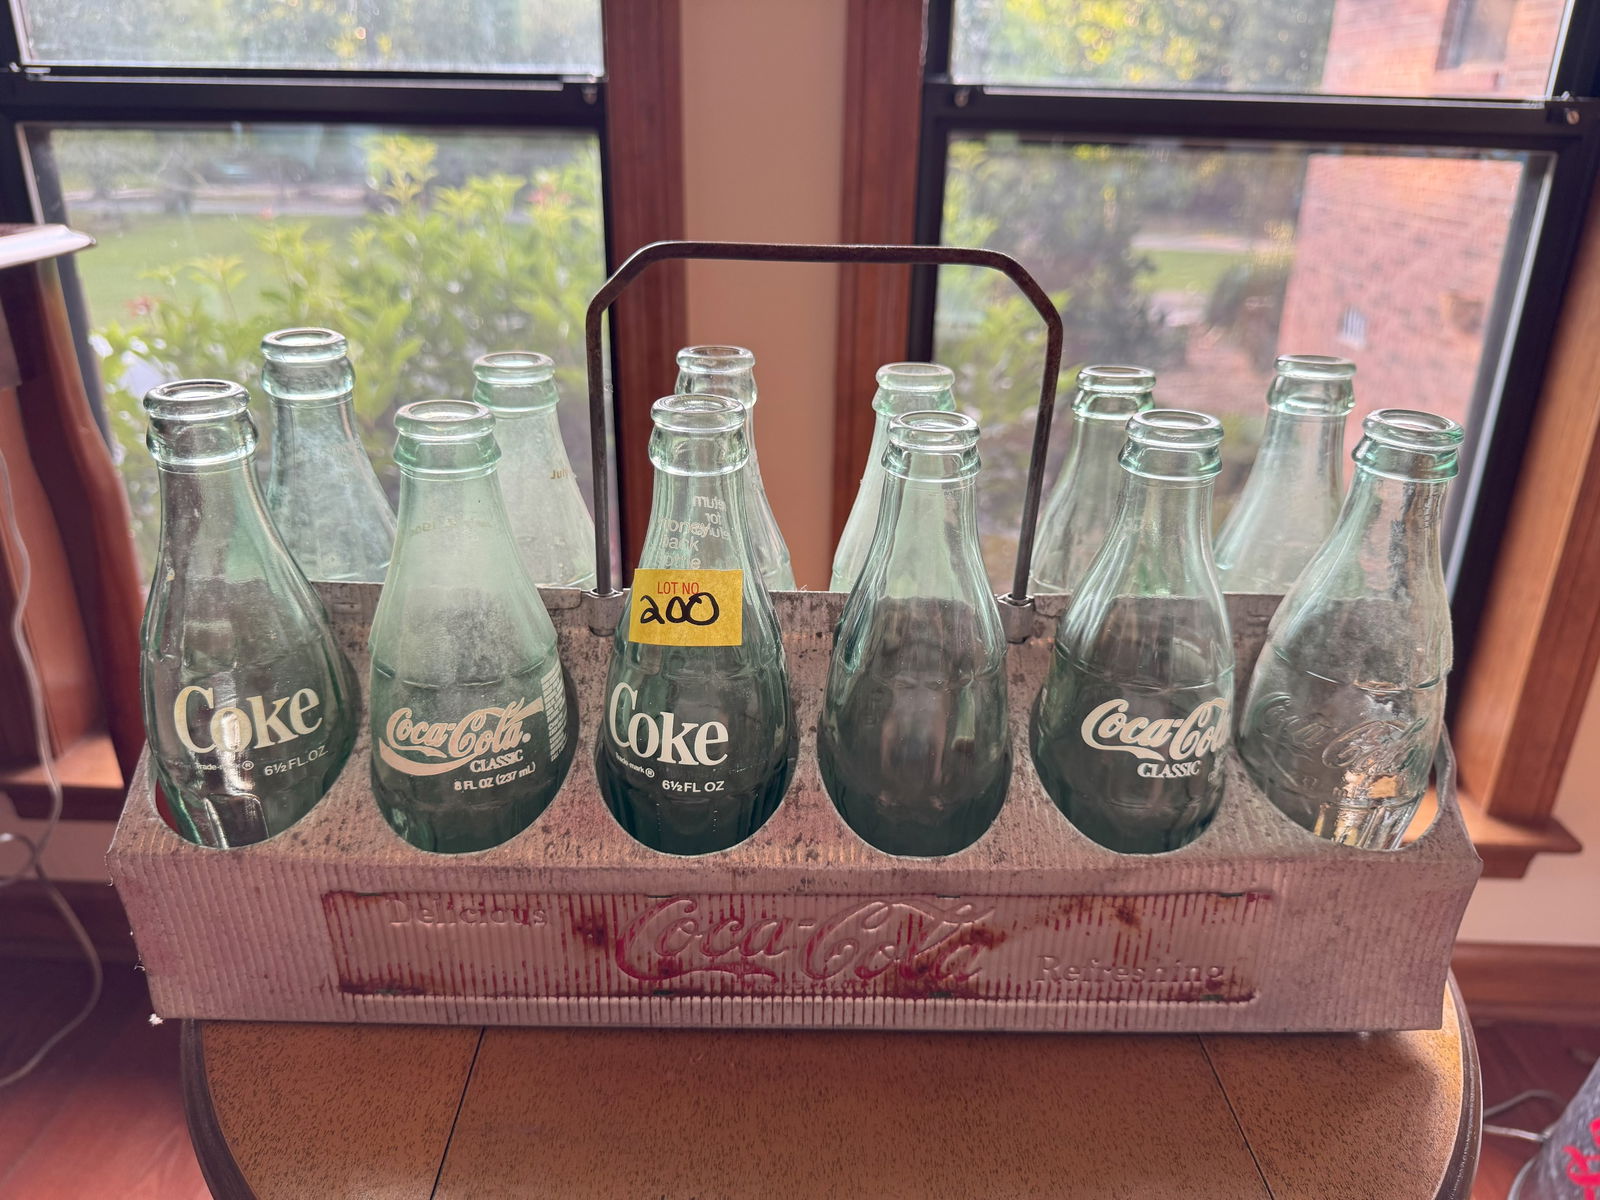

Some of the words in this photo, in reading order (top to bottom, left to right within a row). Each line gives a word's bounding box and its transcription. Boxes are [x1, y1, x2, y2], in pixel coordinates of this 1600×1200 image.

[657, 581, 678, 594] LOT
[640, 592, 720, 626] 200
[174, 685, 323, 754] Coke
[386, 697, 538, 758] Coca-Cola
[609, 682, 729, 766] Coke
[469, 749, 524, 773] CLASSIC
[1136, 760, 1202, 779] CLASSIC
[453, 780, 462, 791] 8
[463, 780, 478, 790] FL
[478, 777, 495, 789] OZ
[704, 780, 725, 792] OZ
[388, 897, 549, 928] Delicious
[615, 895, 994, 981] Coca-Cola
[1036, 954, 1224, 991] Refreshing
